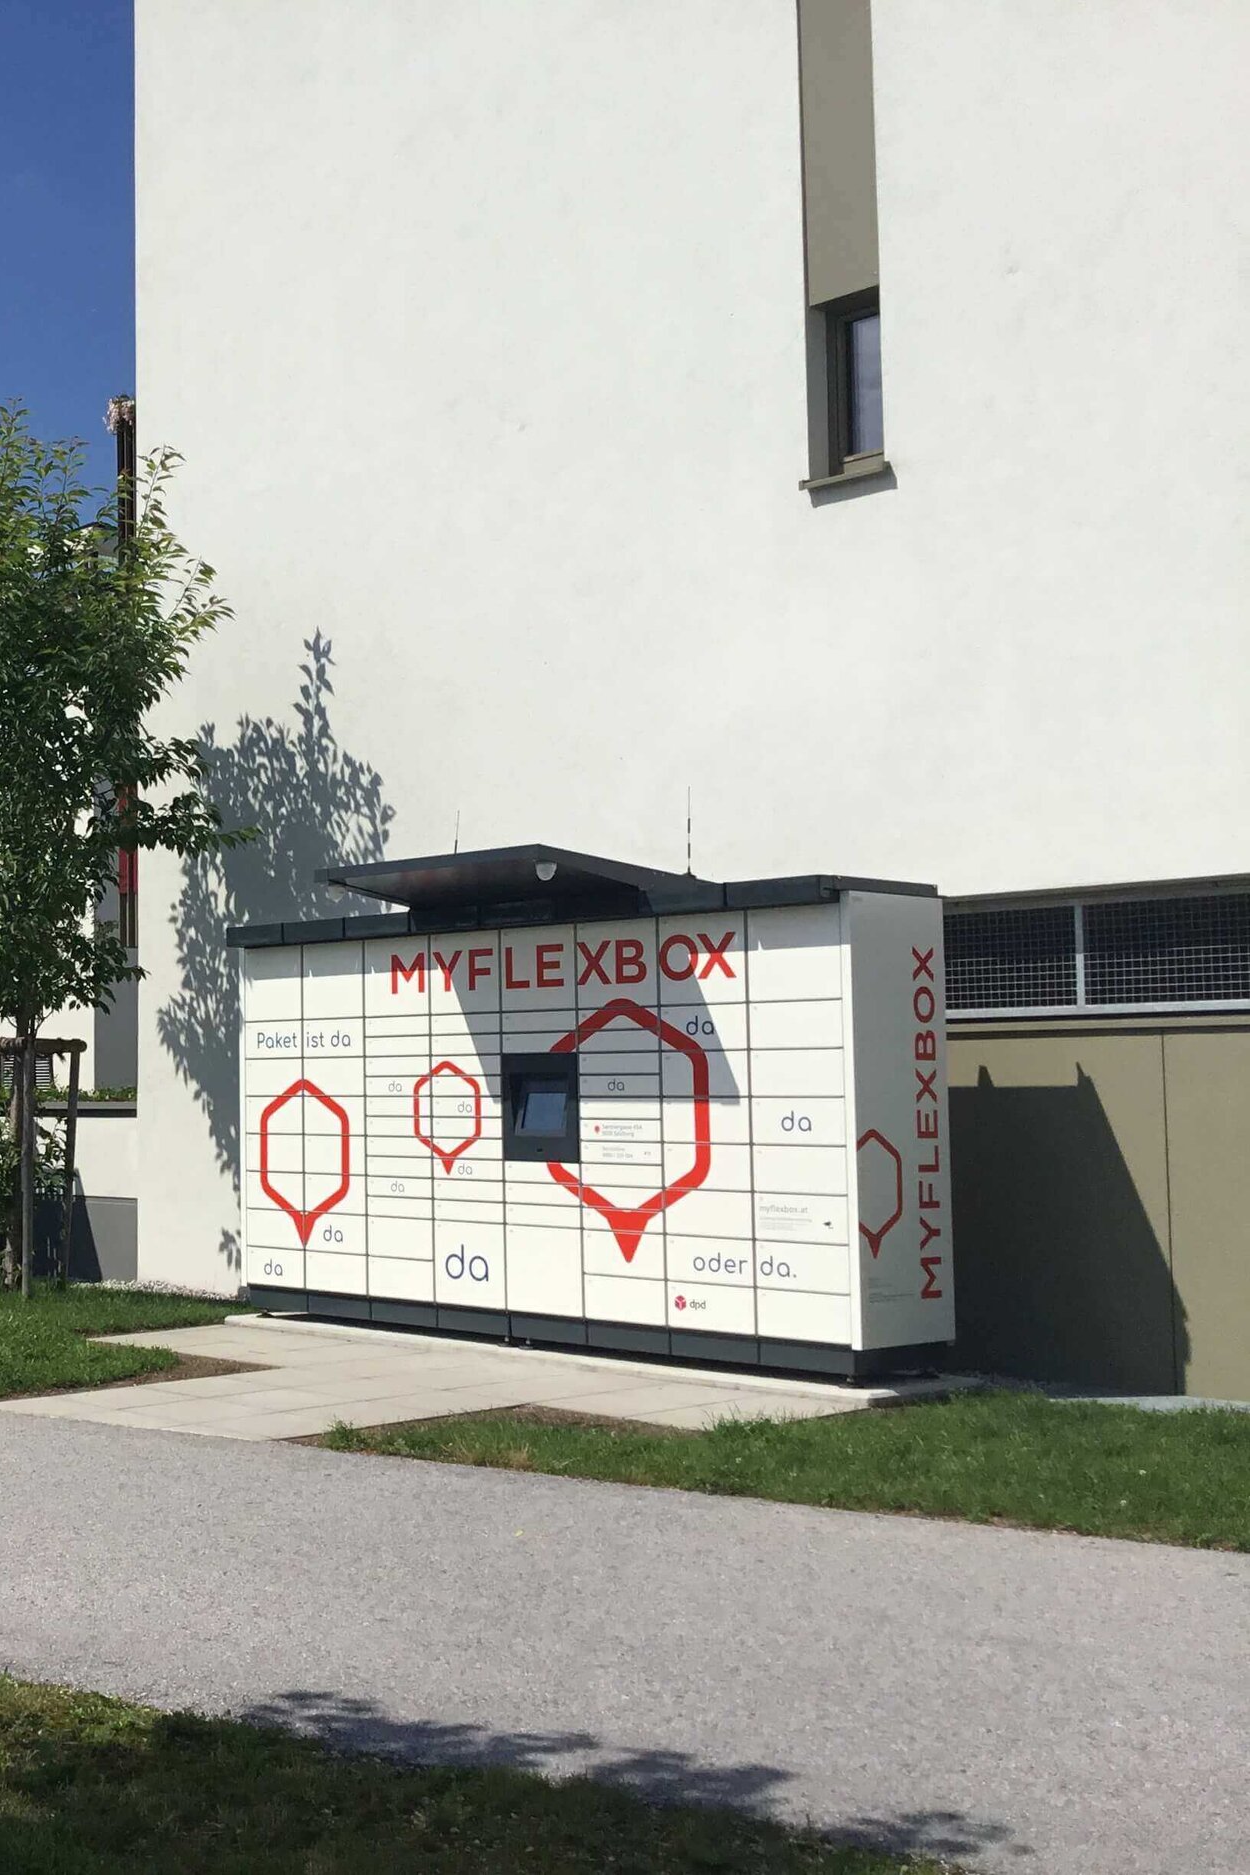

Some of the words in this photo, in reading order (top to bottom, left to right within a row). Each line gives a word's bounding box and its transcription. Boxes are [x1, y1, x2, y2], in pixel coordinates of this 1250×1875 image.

[390, 931, 737, 995] MYFLEXBOX
[686, 1015, 715, 1036] da
[257, 1032, 298, 1049] Paket
[306, 1031, 325, 1048] ist
[331, 1030, 351, 1048] da
[388, 1081, 403, 1092] da
[608, 1078, 625, 1092] da
[457, 1101, 473, 1113] da
[781, 1109, 812, 1132] da
[912, 946, 943, 1299] MYFLEXBOX
[457, 1163, 473, 1175] da
[390, 1181, 405, 1193] da
[323, 1225, 344, 1243] da
[263, 1259, 284, 1276] da
[445, 1244, 489, 1282] da
[693, 1252, 748, 1275] oder
[760, 1255, 797, 1279] da.
[689, 1299, 707, 1311] dpd
